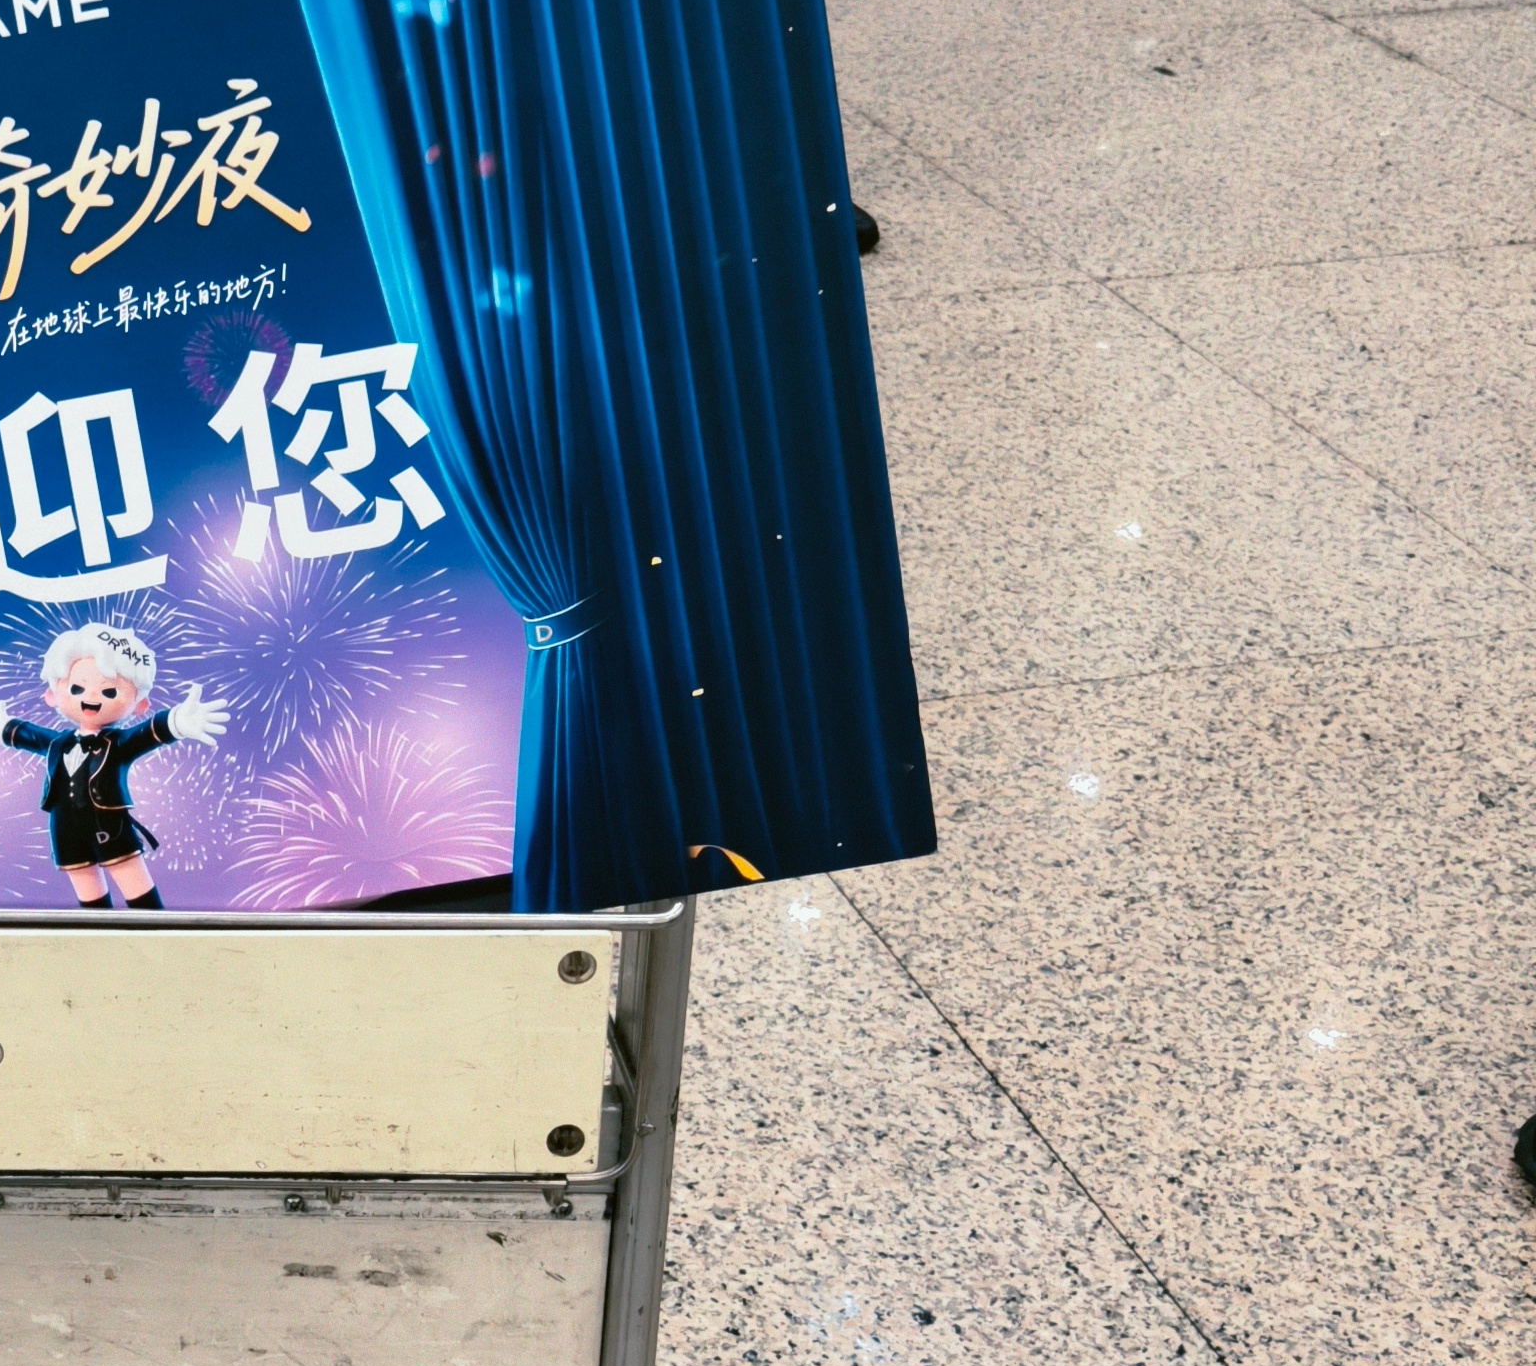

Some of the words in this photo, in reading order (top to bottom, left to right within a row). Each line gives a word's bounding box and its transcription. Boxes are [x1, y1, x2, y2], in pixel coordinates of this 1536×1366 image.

[535, 625, 553, 643] D
[97, 631, 150, 666] DREAME
[95, 831, 110, 844] D
